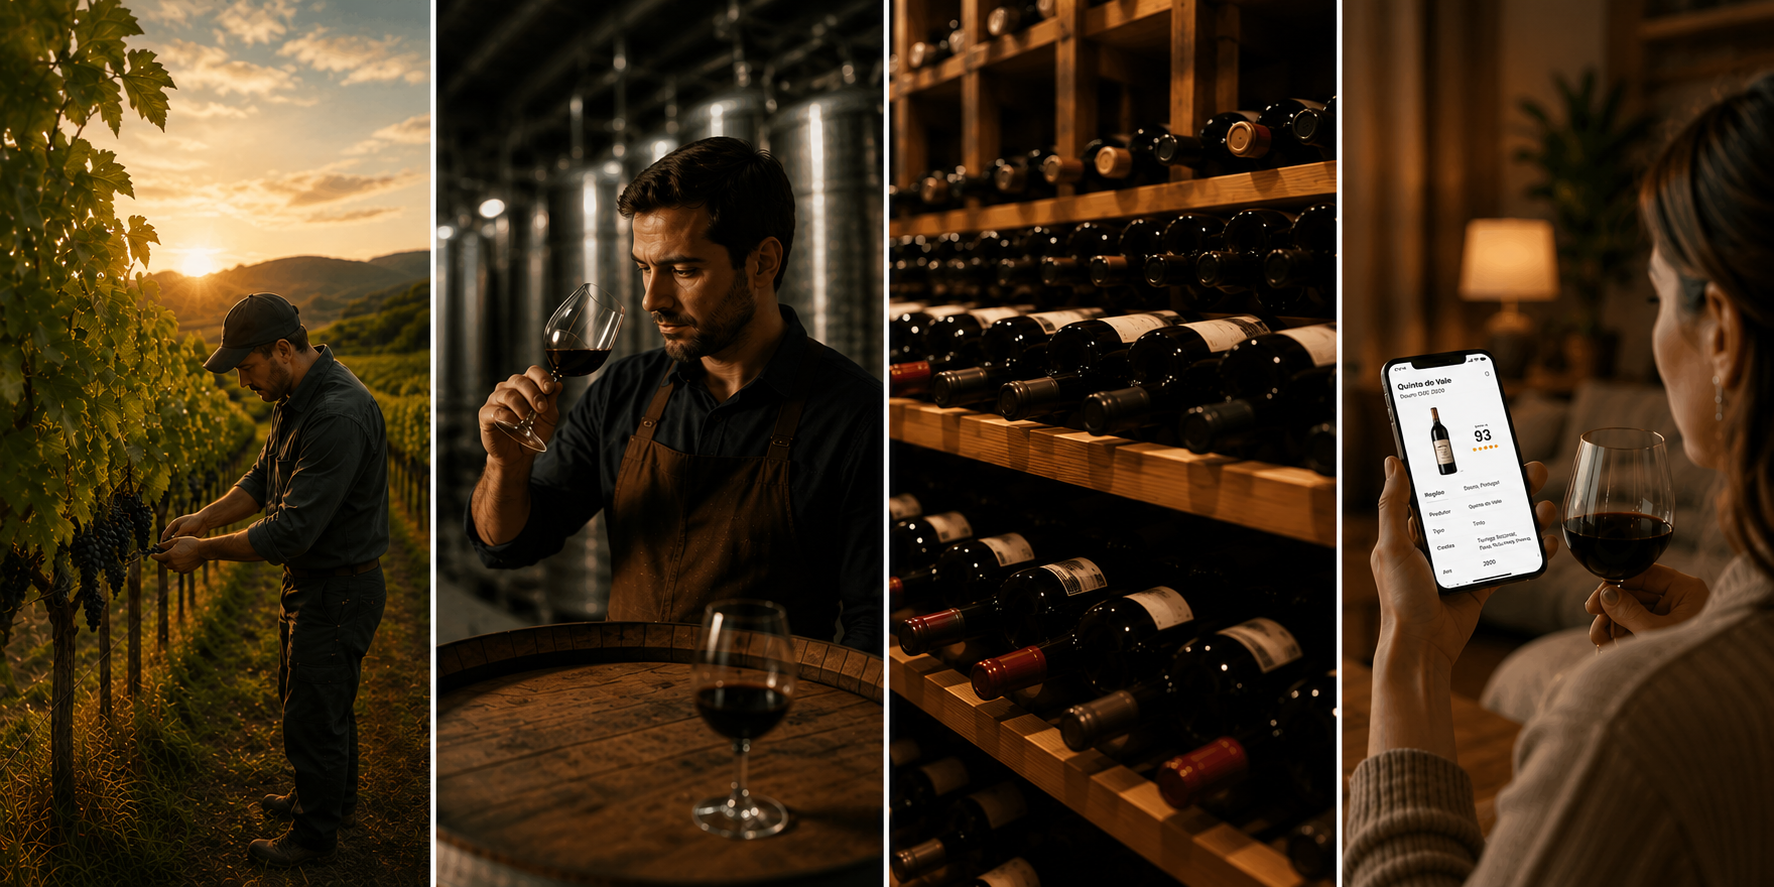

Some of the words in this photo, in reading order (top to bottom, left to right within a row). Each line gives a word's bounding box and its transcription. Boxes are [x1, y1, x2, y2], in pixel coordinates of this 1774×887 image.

[1397, 381, 1424, 390] Quinta
[1435, 377, 1452, 385] Vale
[1474, 429, 1492, 442] 93
